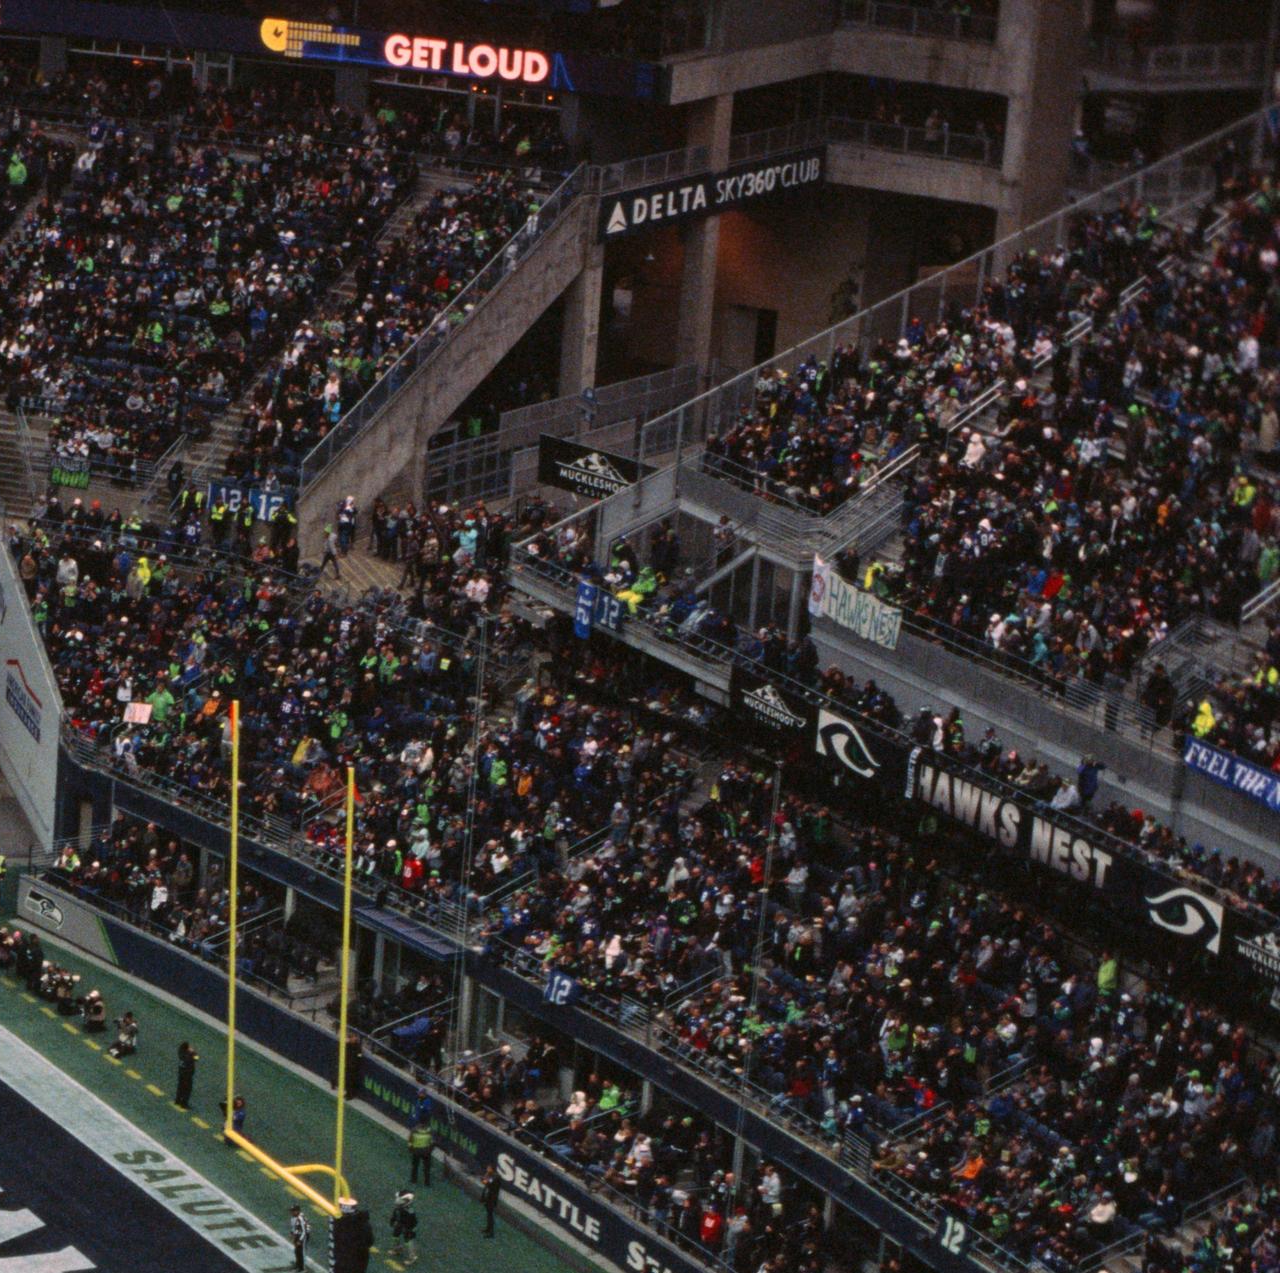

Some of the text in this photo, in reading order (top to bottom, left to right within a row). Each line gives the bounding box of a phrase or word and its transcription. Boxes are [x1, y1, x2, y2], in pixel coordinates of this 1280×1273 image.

[383, 34, 550, 82] GET LOUD
[632, 184, 707, 224] DELTA
[220, 487, 241, 513] 12
[1184, 742, 1230, 780] FEEL
[1233, 763, 1272, 797] THE
[919, 764, 1021, 848] HAWKS
[1031, 816, 1112, 890] NEST
[548, 975, 572, 1006] 12
[113, 1149, 278, 1253] SALUTE
[497, 1152, 601, 1242] SEATTLE
[940, 1215, 966, 1255] 12
